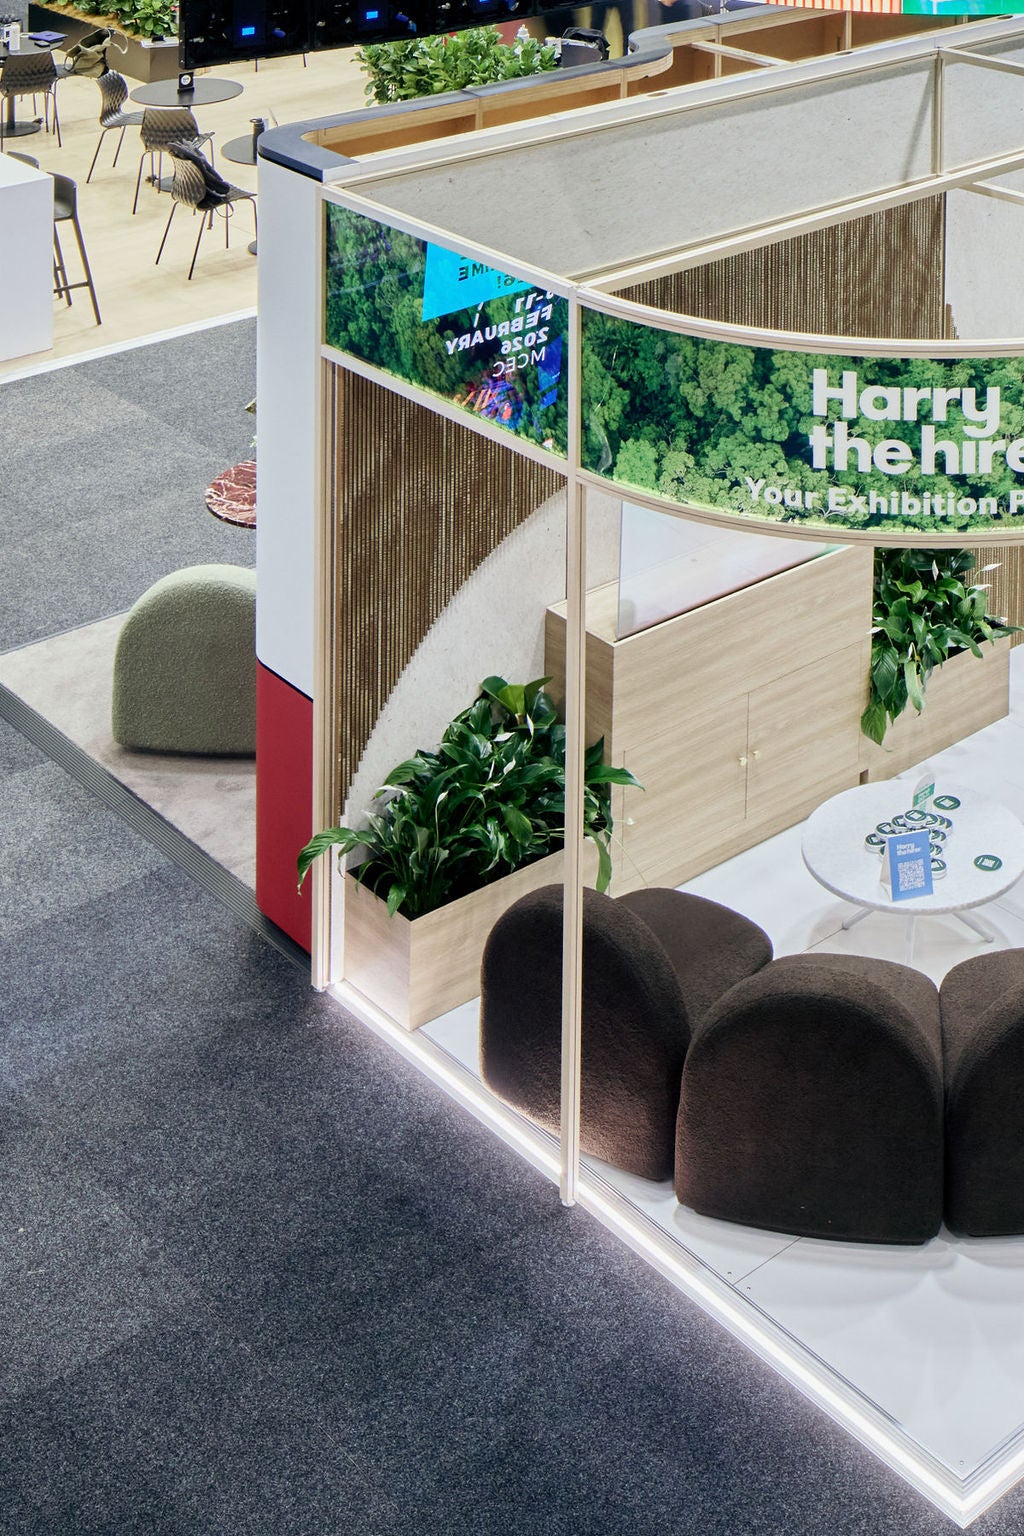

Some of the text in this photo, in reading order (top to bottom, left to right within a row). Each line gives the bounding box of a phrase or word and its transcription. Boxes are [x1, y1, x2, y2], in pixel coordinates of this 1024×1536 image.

[812, 367, 1001, 439] Harry
[808, 421, 914, 475] the
[744, 477, 822, 511] Your
[828, 487, 999, 517] Exhibition
